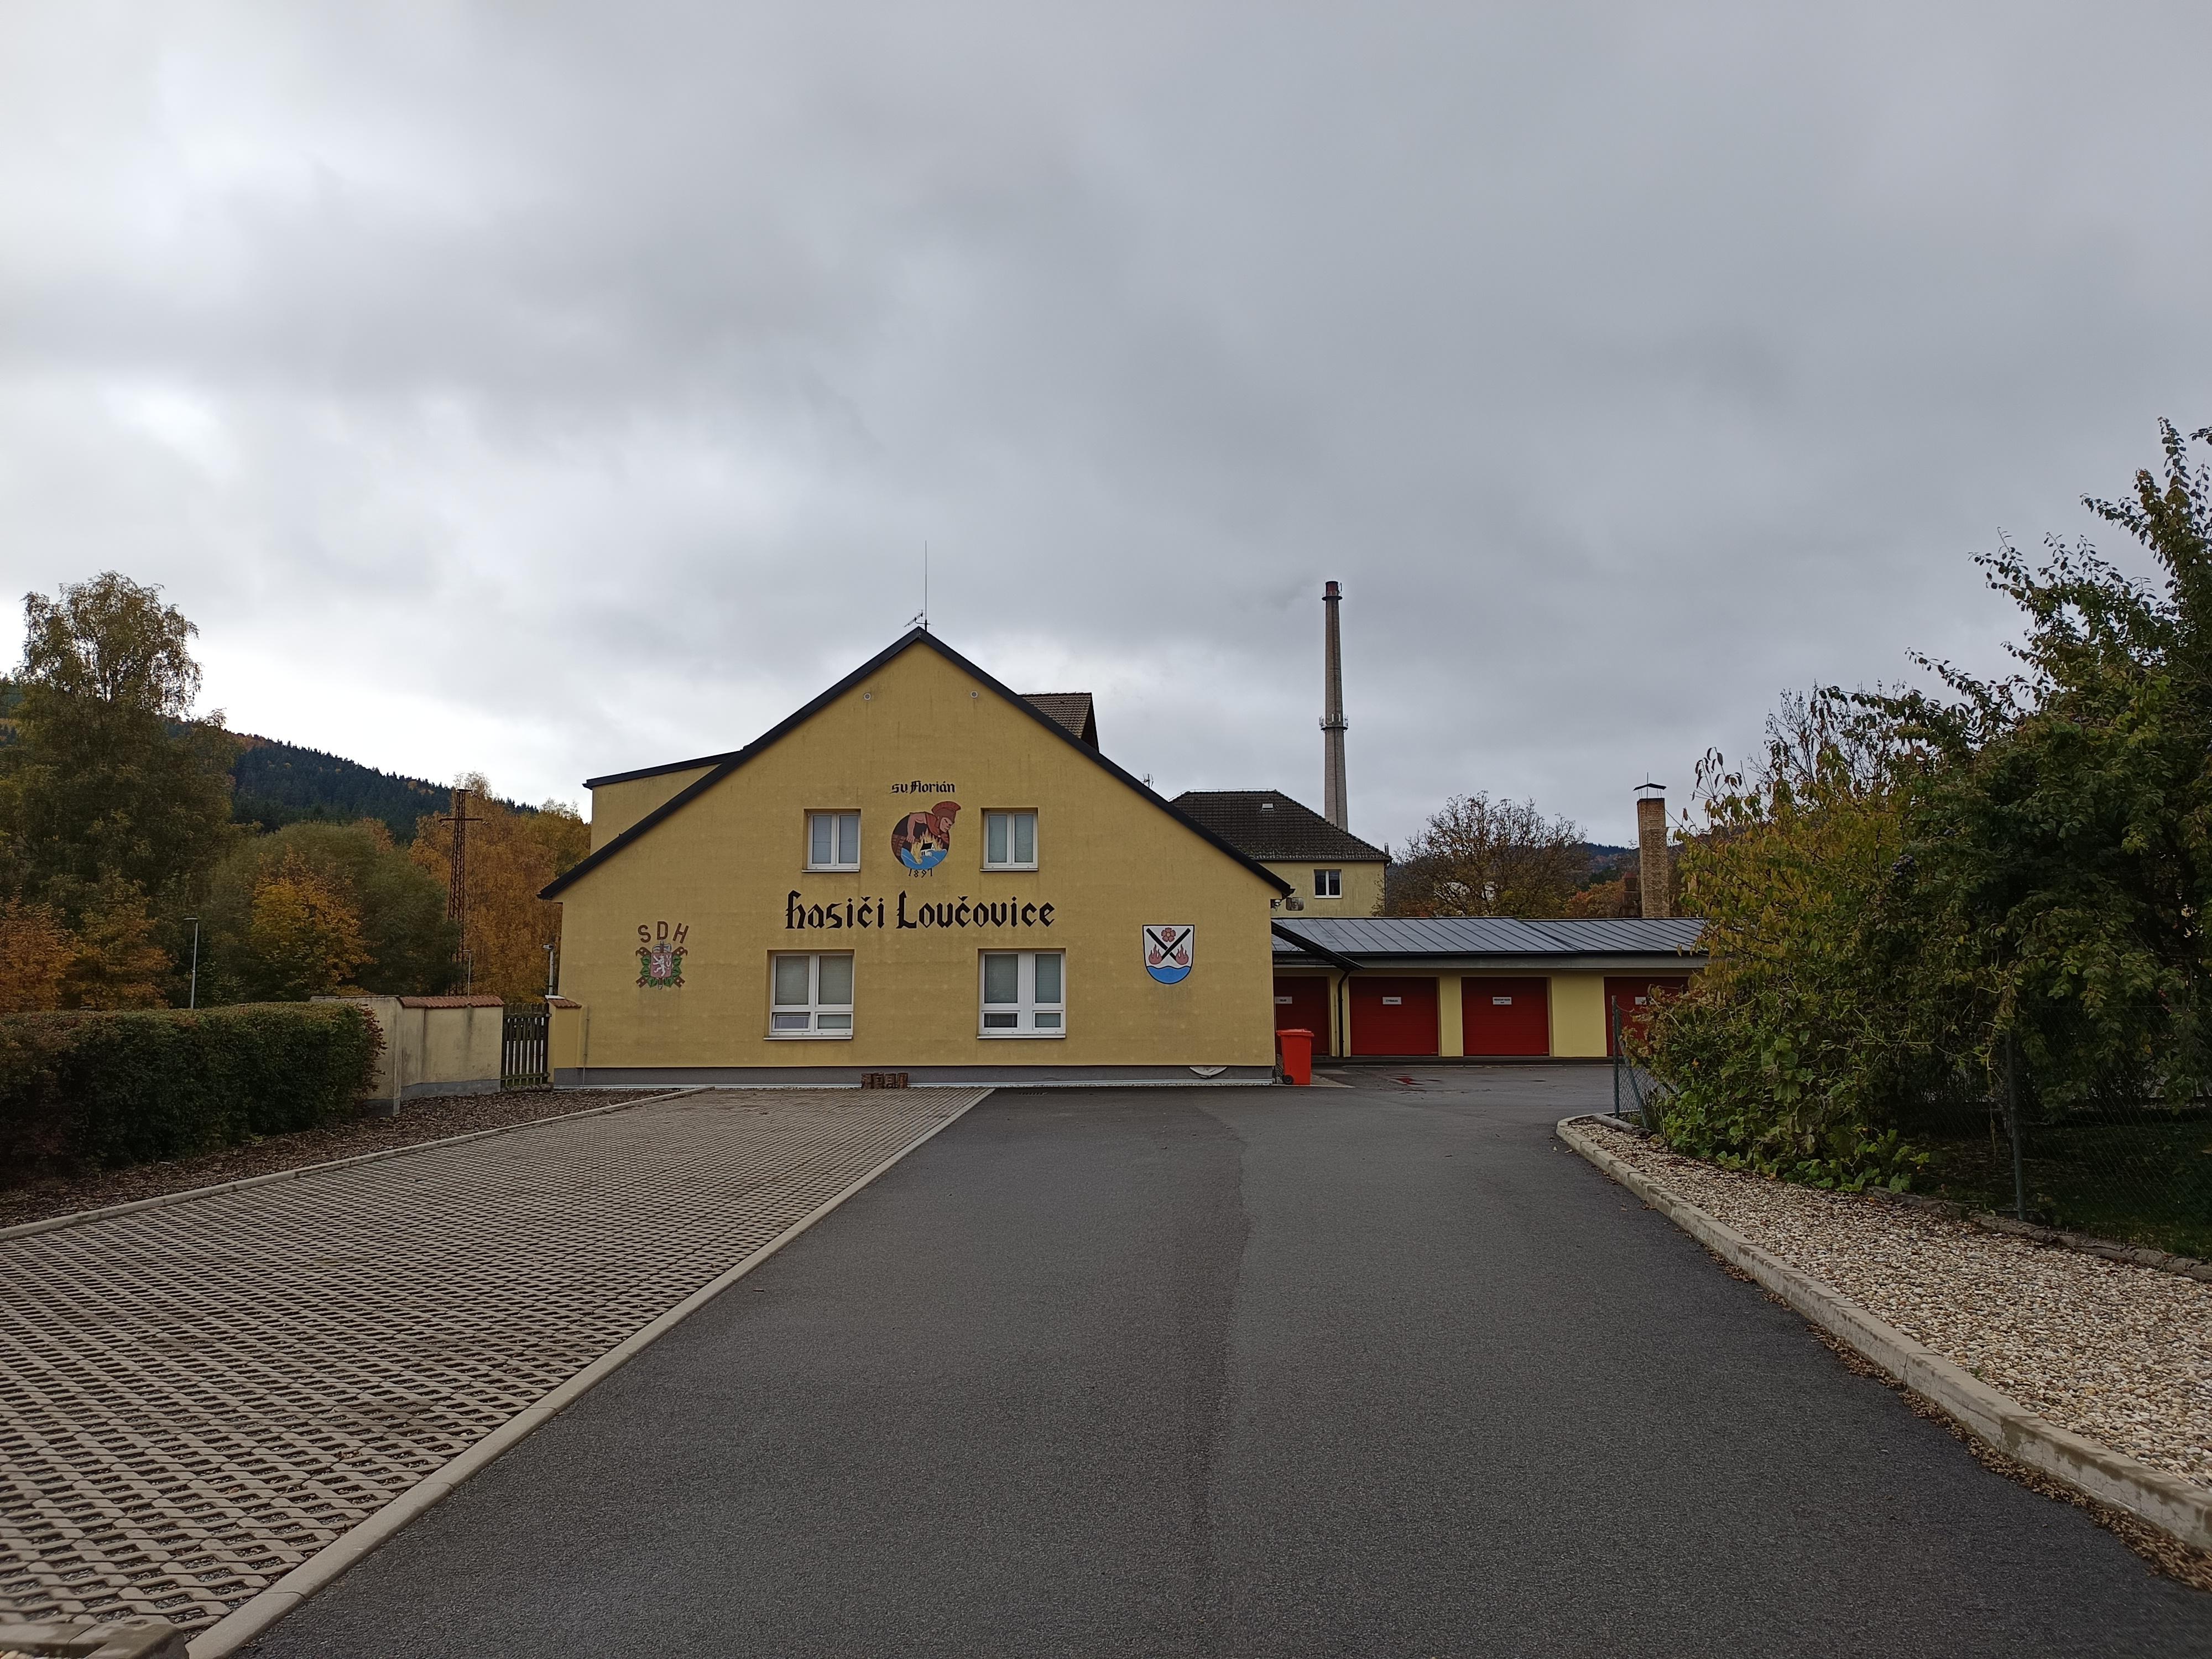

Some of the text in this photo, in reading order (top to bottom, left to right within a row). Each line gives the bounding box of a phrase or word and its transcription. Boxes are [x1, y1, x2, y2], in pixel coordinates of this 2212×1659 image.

[910, 780, 956, 794] Florián
[908, 867, 933, 878] 1897
[895, 890, 1055, 929] Loučovice
[638, 921, 689, 944] SDH
